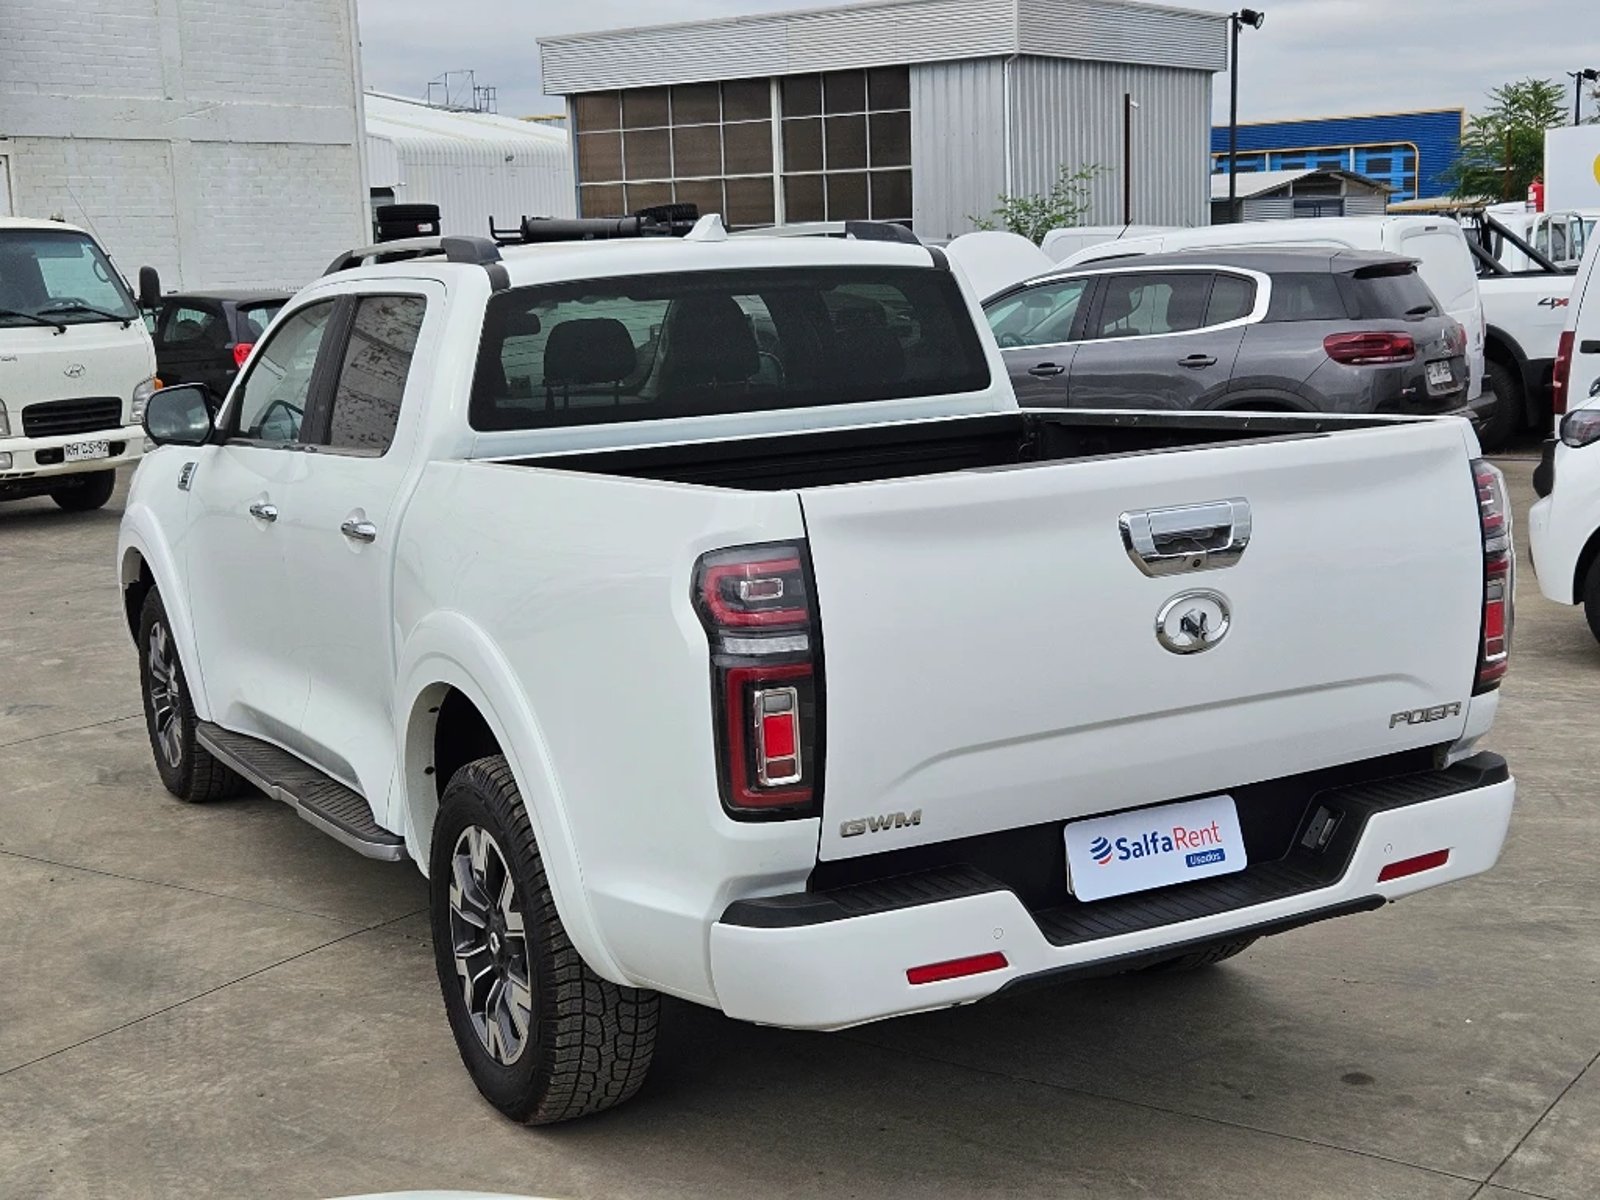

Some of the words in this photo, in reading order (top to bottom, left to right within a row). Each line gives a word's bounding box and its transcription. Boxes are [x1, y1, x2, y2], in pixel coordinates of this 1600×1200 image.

[1388, 701, 1462, 729] POER
[840, 808, 922, 838] GWM
[1115, 820, 1223, 861] SalfaRent
[1189, 851, 1222, 866] Usados
